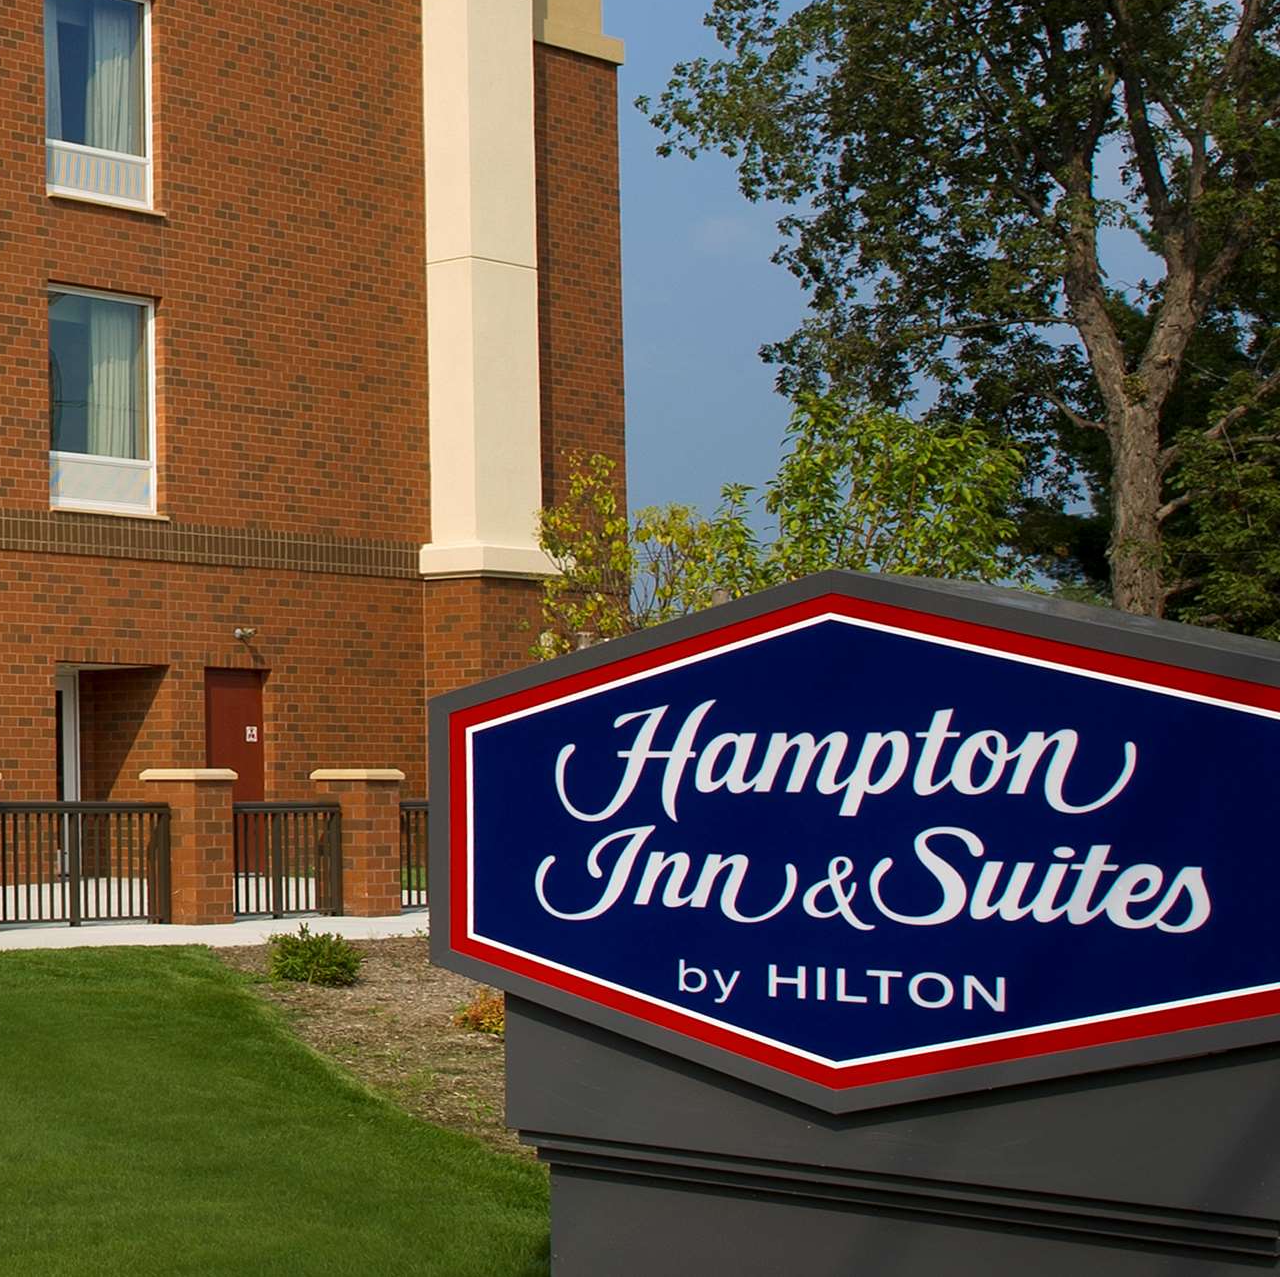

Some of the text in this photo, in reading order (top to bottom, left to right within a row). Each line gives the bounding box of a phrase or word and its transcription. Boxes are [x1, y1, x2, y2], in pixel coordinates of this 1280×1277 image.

[555, 699, 1137, 823] Hampton
[534, 824, 1211, 933] Inn & Suites
[678, 959, 1006, 1012] by HILTON
